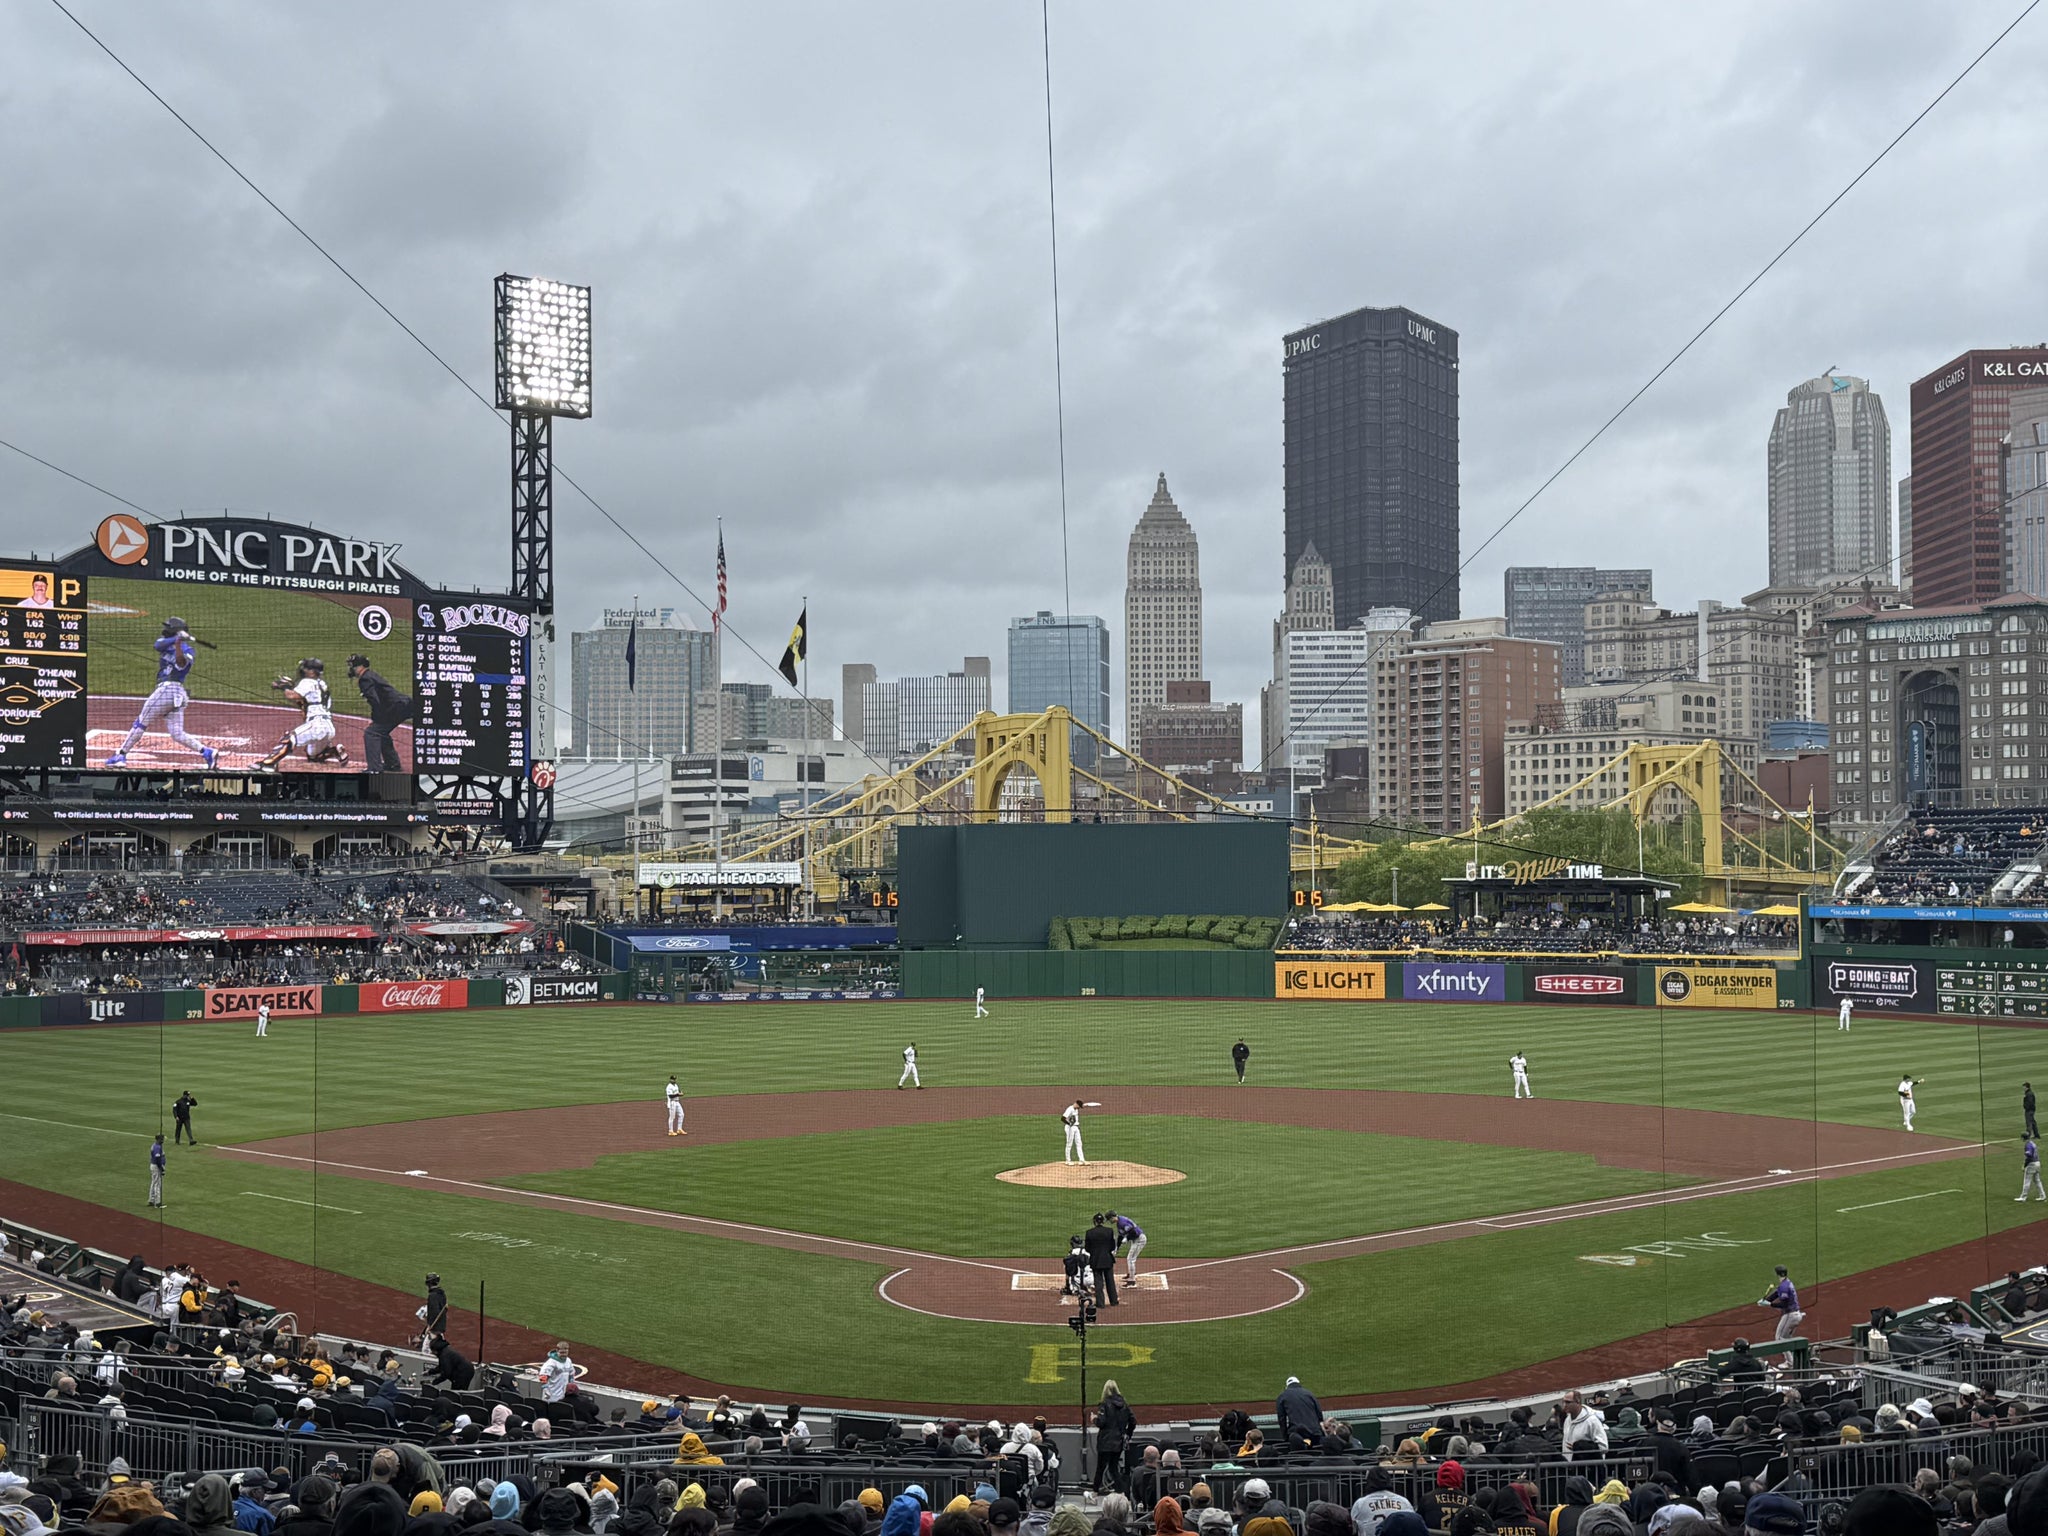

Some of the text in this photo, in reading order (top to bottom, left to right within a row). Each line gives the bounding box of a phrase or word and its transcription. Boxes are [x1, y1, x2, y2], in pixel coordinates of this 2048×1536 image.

[1408, 319, 1436, 344] UPMC
[1284, 334, 1320, 359] UPMC
[1984, 363, 2014, 376] K&L
[1934, 367, 1965, 395] K&L GATES
[158, 524, 403, 580] PNC PARK
[165, 568, 401, 595] HOME OF THE PITTSBURGH PIRATES
[61, 579, 80, 605] P
[26, 611, 82, 621] ERA WHIP
[369, 611, 381, 633] 5
[440, 604, 530, 637] ROCKIES
[26, 619, 79, 630] 1.62 1.02
[24, 632, 47, 640] BB/9
[438, 635, 458, 643] BECK
[1898, 633, 1957, 644] RENAISSANCE
[60, 641, 79, 650] 5.25
[417, 643, 423, 651] 9
[438, 645, 461, 653] DOYLE
[5, 656, 29, 665] CRUZ
[538, 645, 546, 671] EAT
[38, 668, 76, 678] O'HEARN
[416, 671, 475, 683] 3 3B CASTRO
[33, 679, 58, 687] LOWE
[38, 690, 77, 699] HORWITZ
[423, 706, 433, 714] 27
[538, 705, 546, 757] CHIKIN
[438, 739, 475, 747] JOHNSTON
[416, 747, 424, 755] 14
[61, 757, 72, 765] 1-1
[12, 811, 29, 819] PNC
[53, 811, 67, 819] The
[67, 811, 94, 819] Official
[94, 811, 112, 819] Bank
[113, 811, 120, 819] of
[121, 811, 133, 819] the
[134, 812, 169, 820] Pittsburgh
[333, 814, 365, 822] Pittsburgh
[414, 814, 428, 822] PNC
[1480, 865, 1506, 879] IT'S
[1503, 855, 1572, 886] Miller
[1566, 865, 1603, 879] TIME
[679, 871, 786, 885] FAT HEAD'S
[873, 892, 898, 906] 0:15
[1295, 890, 1322, 906] 0:15
[1066, 914, 1283, 950] PIRATES
[665, 939, 700, 948] Ford
[1314, 972, 1375, 990] LIGHT
[1417, 969, 1491, 995] xfinity
[1541, 979, 1617, 991] SHEETZ
[1694, 975, 1773, 988] EDGAR SNYDER
[1834, 969, 1846, 988] P
[1849, 970, 1881, 983] GOING
[1890, 971, 1910, 984] BAT
[533, 980, 598, 997] BETMGM
[1714, 987, 1754, 996] & ASSOCIATES
[211, 989, 315, 1015] SEATGEEK
[382, 984, 445, 1008] Coca-Cola
[89, 999, 126, 1021] Lite
[1621, 1231, 1773, 1258] PNC
[1022, 1342, 1158, 1384] P
[1408, 1421, 1432, 1429] CAUTION
[1805, 1458, 1815, 1466] 15
[543, 1470, 553, 1479] 17
[1632, 1468, 1642, 1477] 16
[1174, 1481, 1185, 1490] 16
[1368, 1499, 1402, 1512] SKENES
[1435, 1493, 1468, 1506] KELLER
